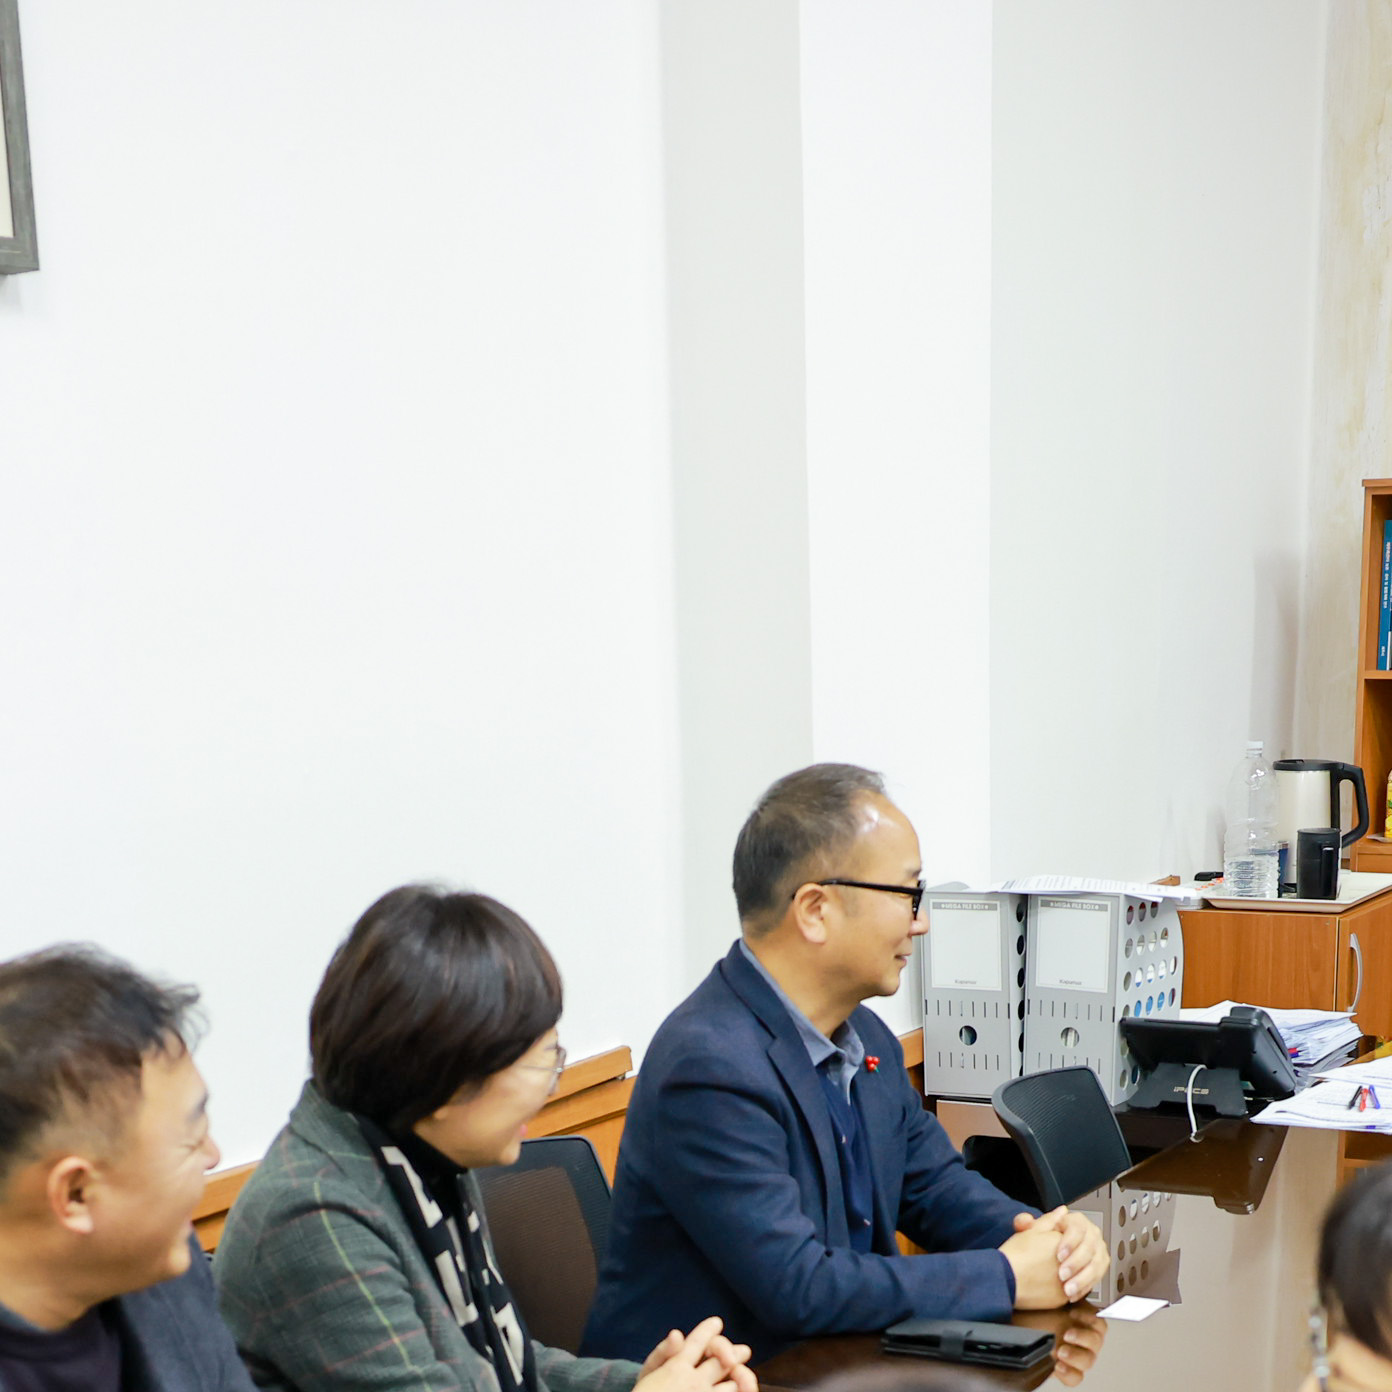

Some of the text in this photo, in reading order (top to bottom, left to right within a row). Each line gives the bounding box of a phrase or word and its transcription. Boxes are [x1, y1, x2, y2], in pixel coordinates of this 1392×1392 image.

[945, 902, 985, 910] MEGA FILE BOX
[1053, 902, 1096, 910] MEGA FILE BOX
